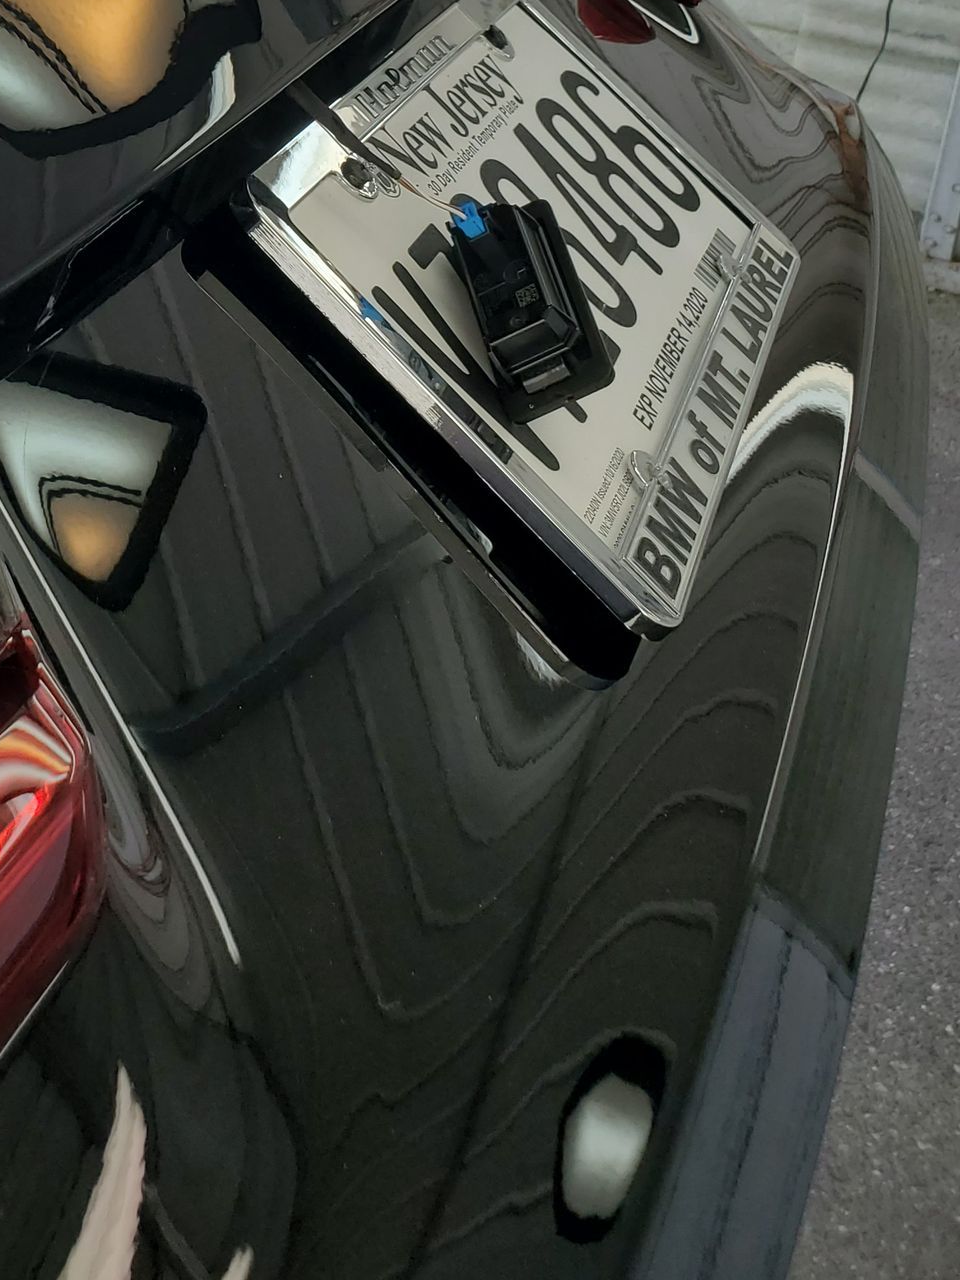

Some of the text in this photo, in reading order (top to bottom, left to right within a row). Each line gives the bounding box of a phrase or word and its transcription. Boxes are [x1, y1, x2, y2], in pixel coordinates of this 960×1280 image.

[364, 54, 524, 177] New Jersey
[427, 100, 519, 196] 30 Day Resident Temporary Plate
[632, 286, 709, 432] EXP NOVEMBER 14,2020
[633, 236, 795, 600] BMW of MT. LAUREL
